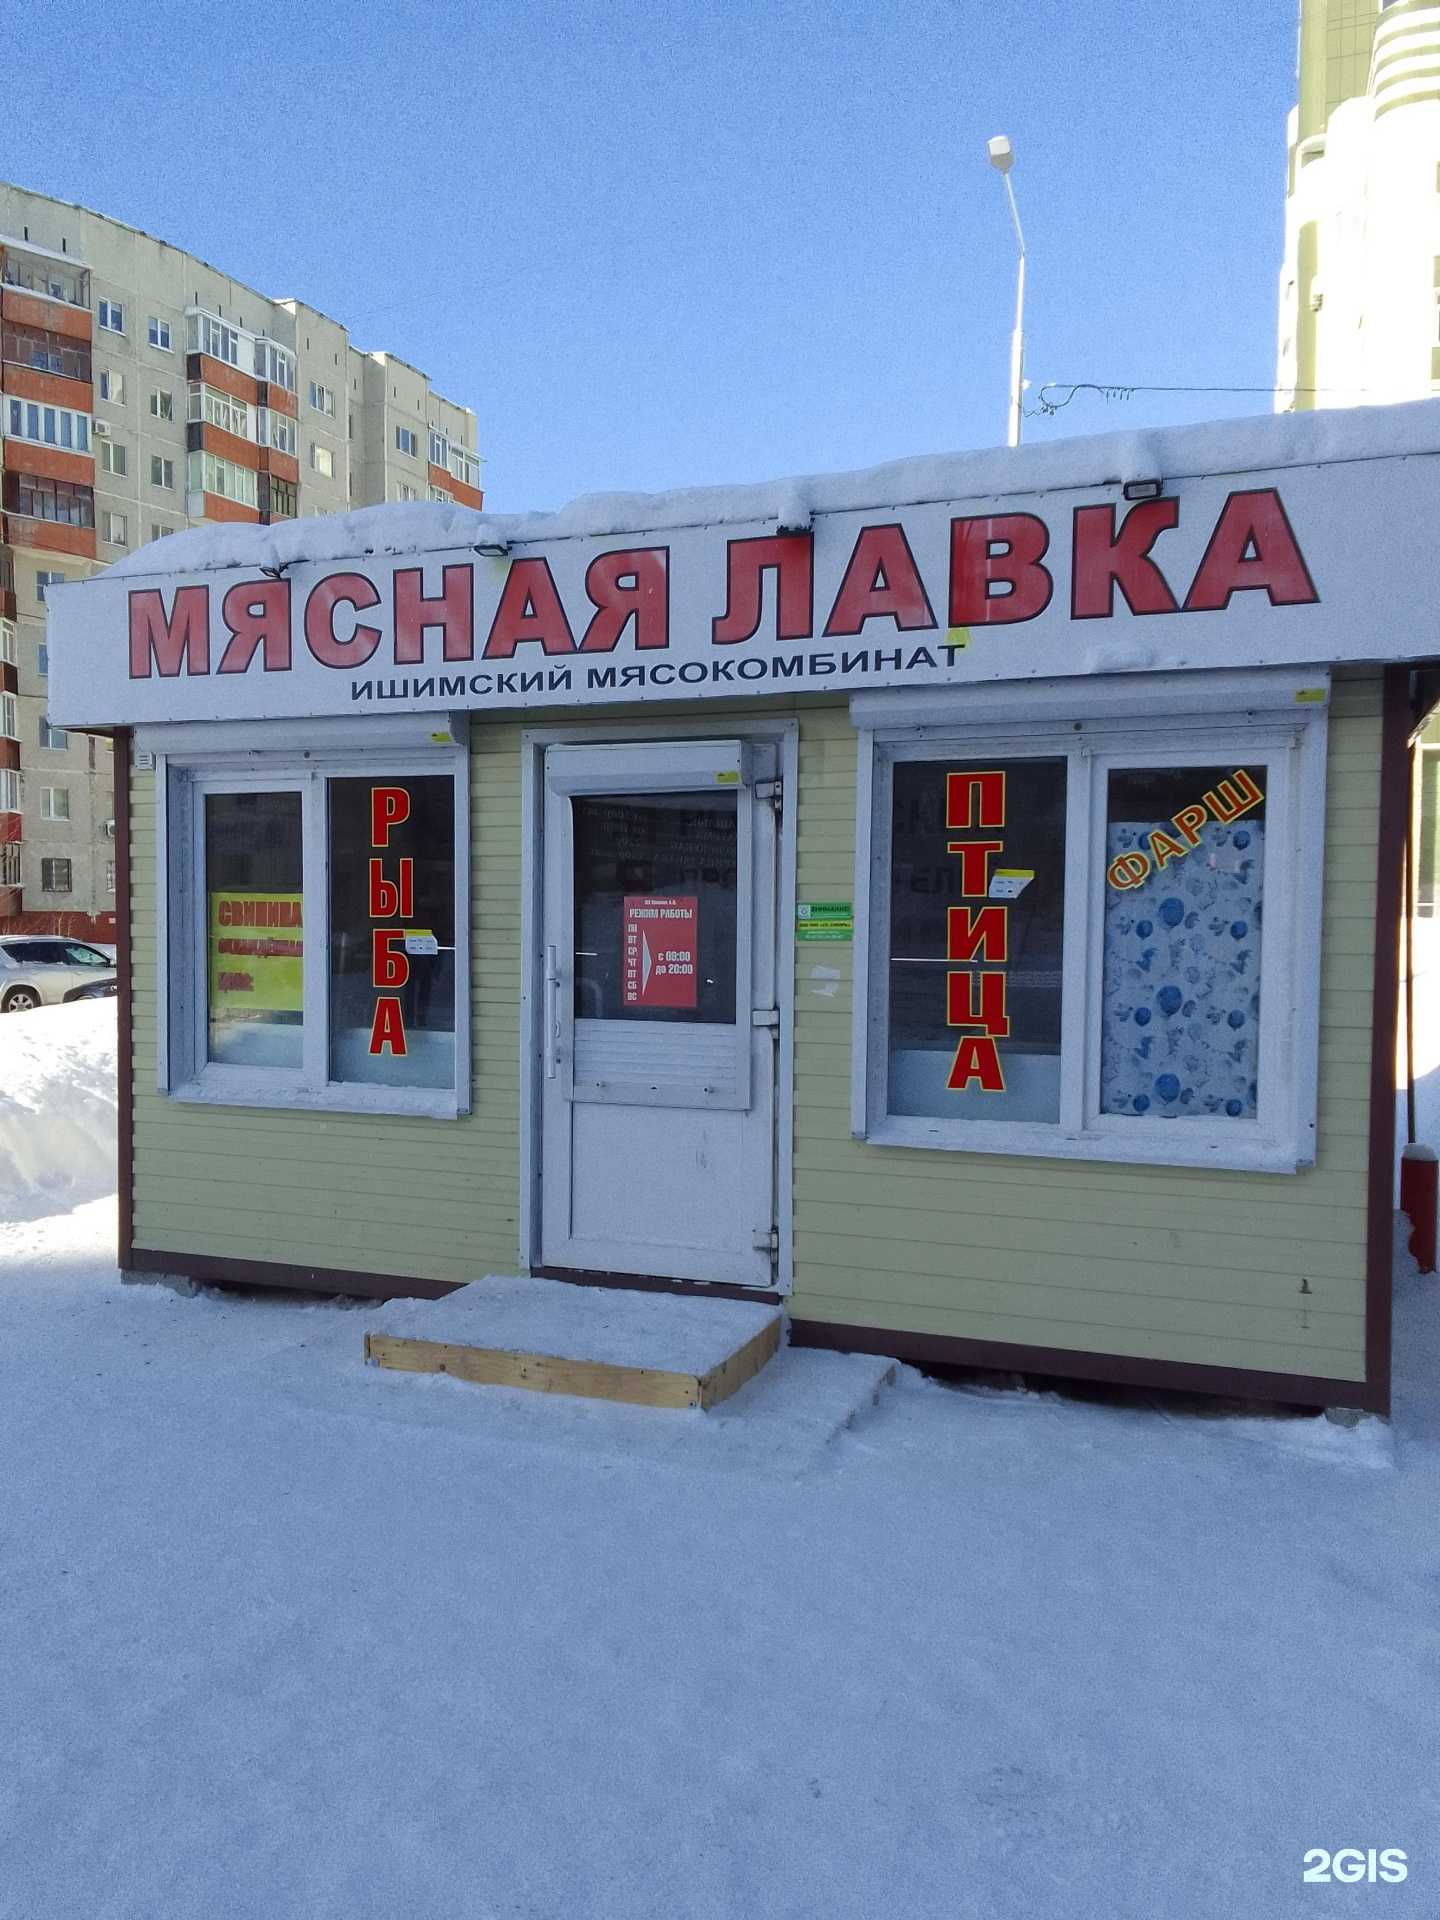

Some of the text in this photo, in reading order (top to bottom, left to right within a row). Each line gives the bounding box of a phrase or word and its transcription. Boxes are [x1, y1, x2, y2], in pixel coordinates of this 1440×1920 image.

[128, 487, 1322, 681] МЯСНАЯ ЛАВКА
[351, 644, 967, 701] ИШИМСКИЙ МЯСОКОМБИНАТ
[1106, 769, 1265, 891] ФАРШ
[367, 786, 414, 1057] РЫБА
[629, 907, 693, 920] РЕЖИМ РАБОТЫ
[945, 770, 1010, 1092] ПТИЦА
